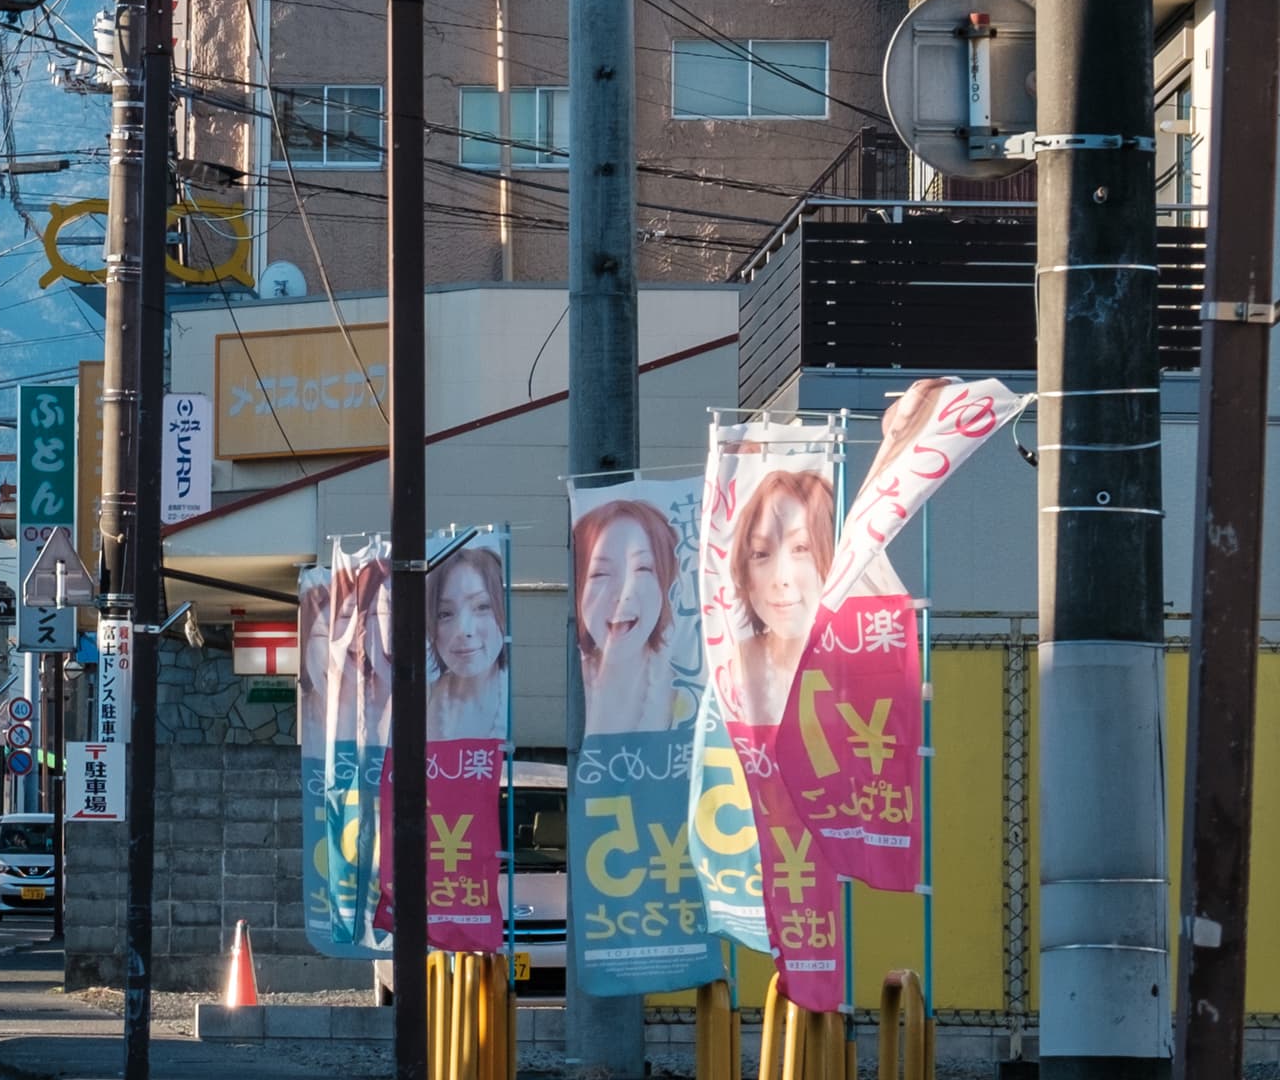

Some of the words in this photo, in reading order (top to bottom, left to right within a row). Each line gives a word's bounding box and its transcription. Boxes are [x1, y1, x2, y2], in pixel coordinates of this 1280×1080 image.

[30, 393, 65, 516] ふとん
[14, 702, 28, 715] 40
[85, 762, 107, 813] 駐車場
